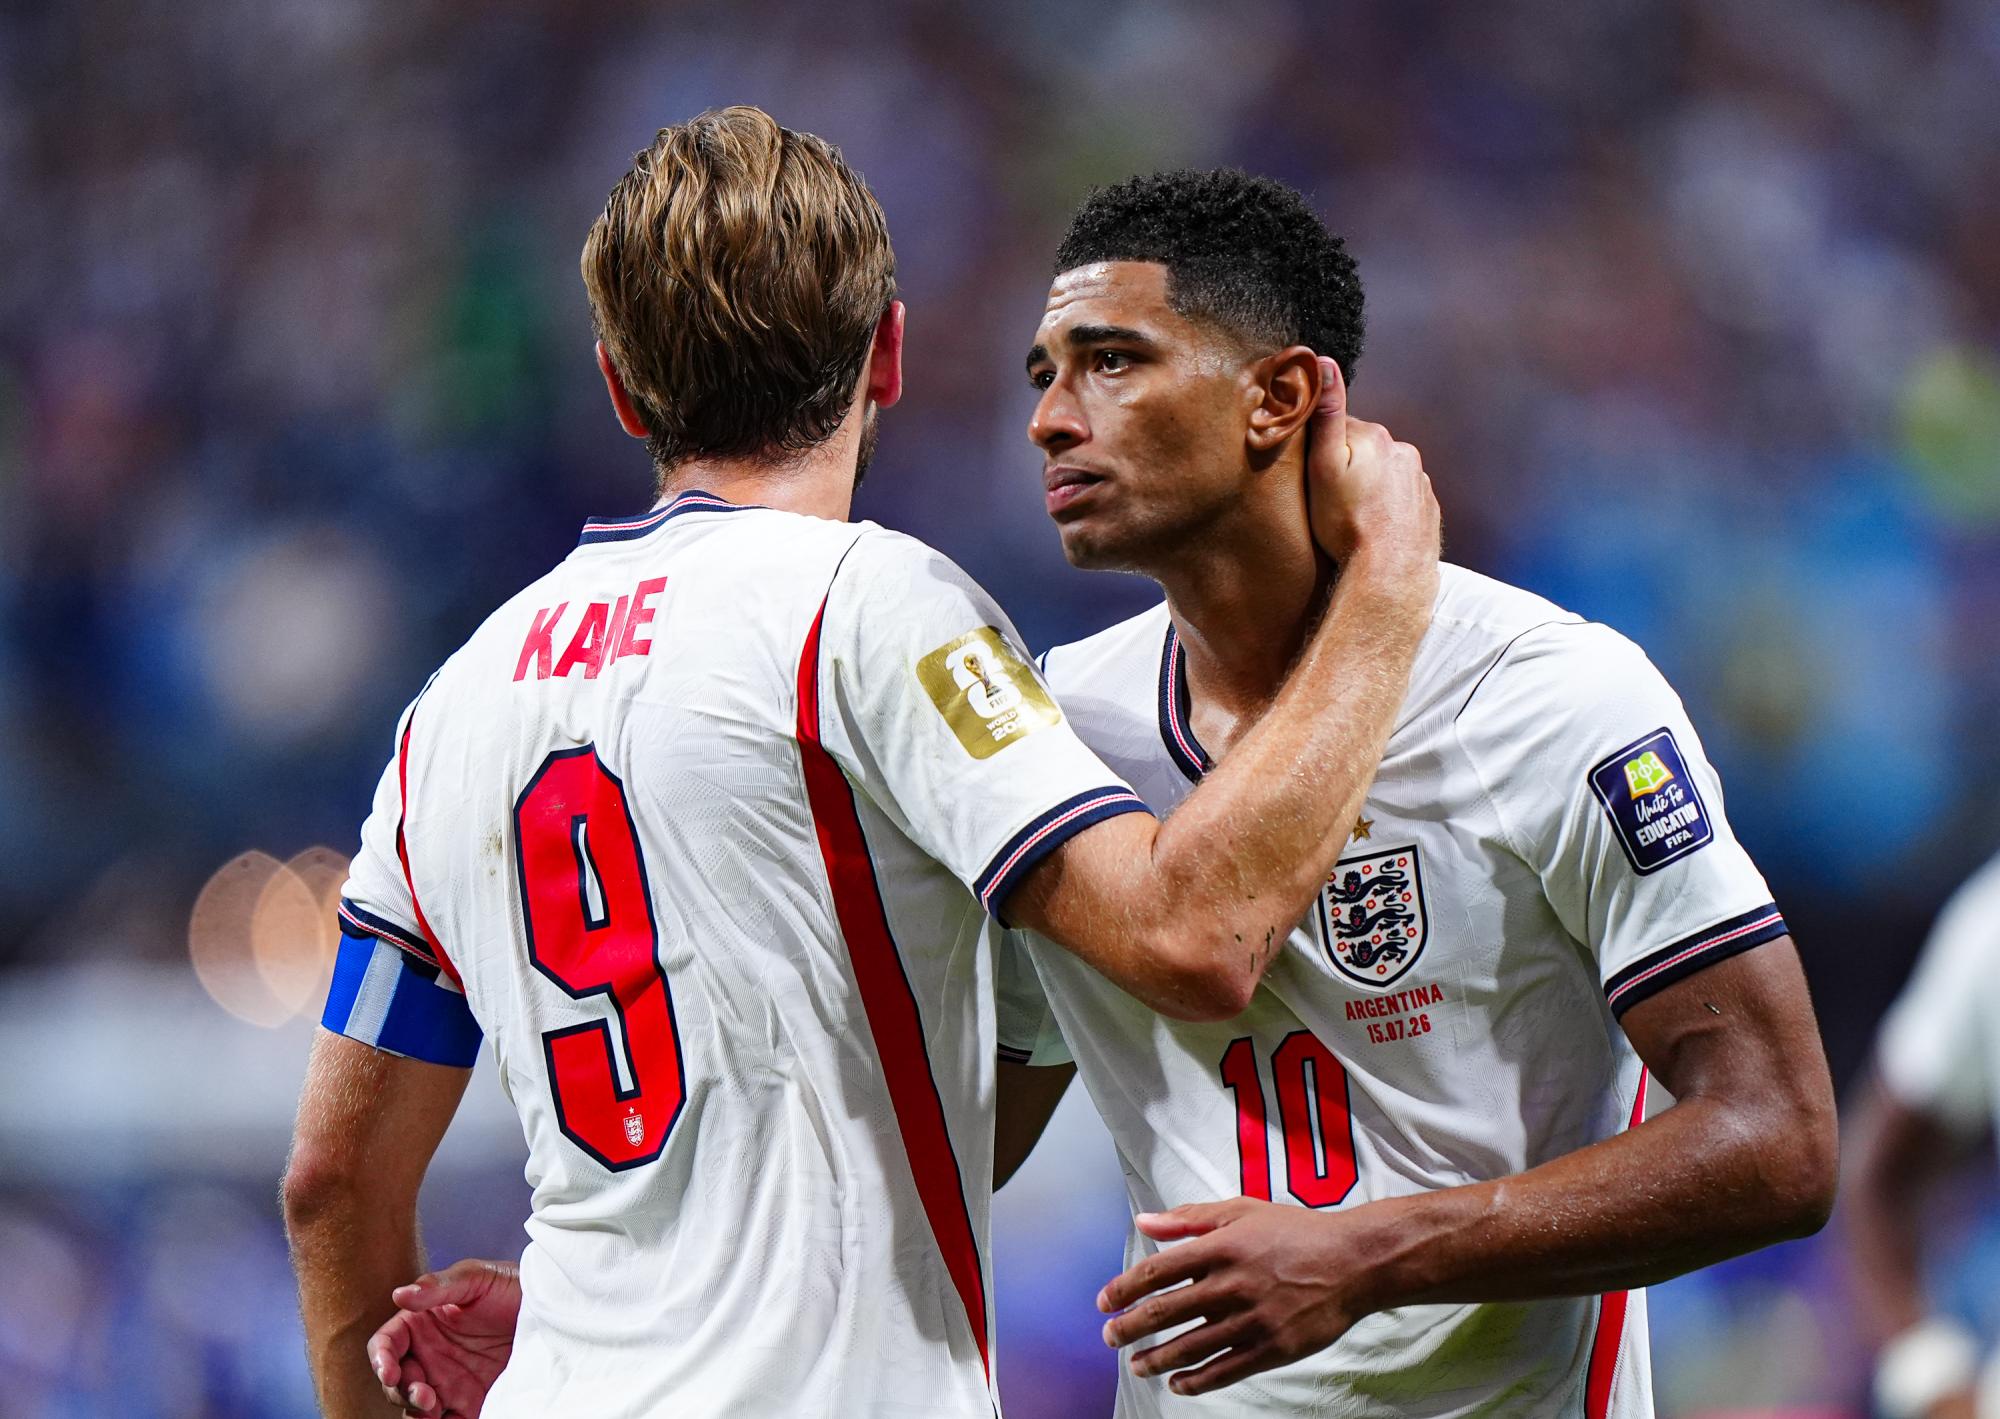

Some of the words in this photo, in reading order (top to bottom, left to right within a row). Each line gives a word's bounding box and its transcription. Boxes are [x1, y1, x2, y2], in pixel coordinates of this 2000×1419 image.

[513, 576, 668, 682] KANE
[986, 711, 1017, 730] WORLD
[1635, 793, 1668, 823] Unite
[1665, 783, 1684, 807] For
[1664, 830, 1692, 849] FIFA
[513, 741, 687, 1173] 9
[1345, 983, 1444, 1021] ARGENTINA
[1366, 1013, 1431, 1044] 15.07.26
[1219, 1029, 1359, 1209] 10
